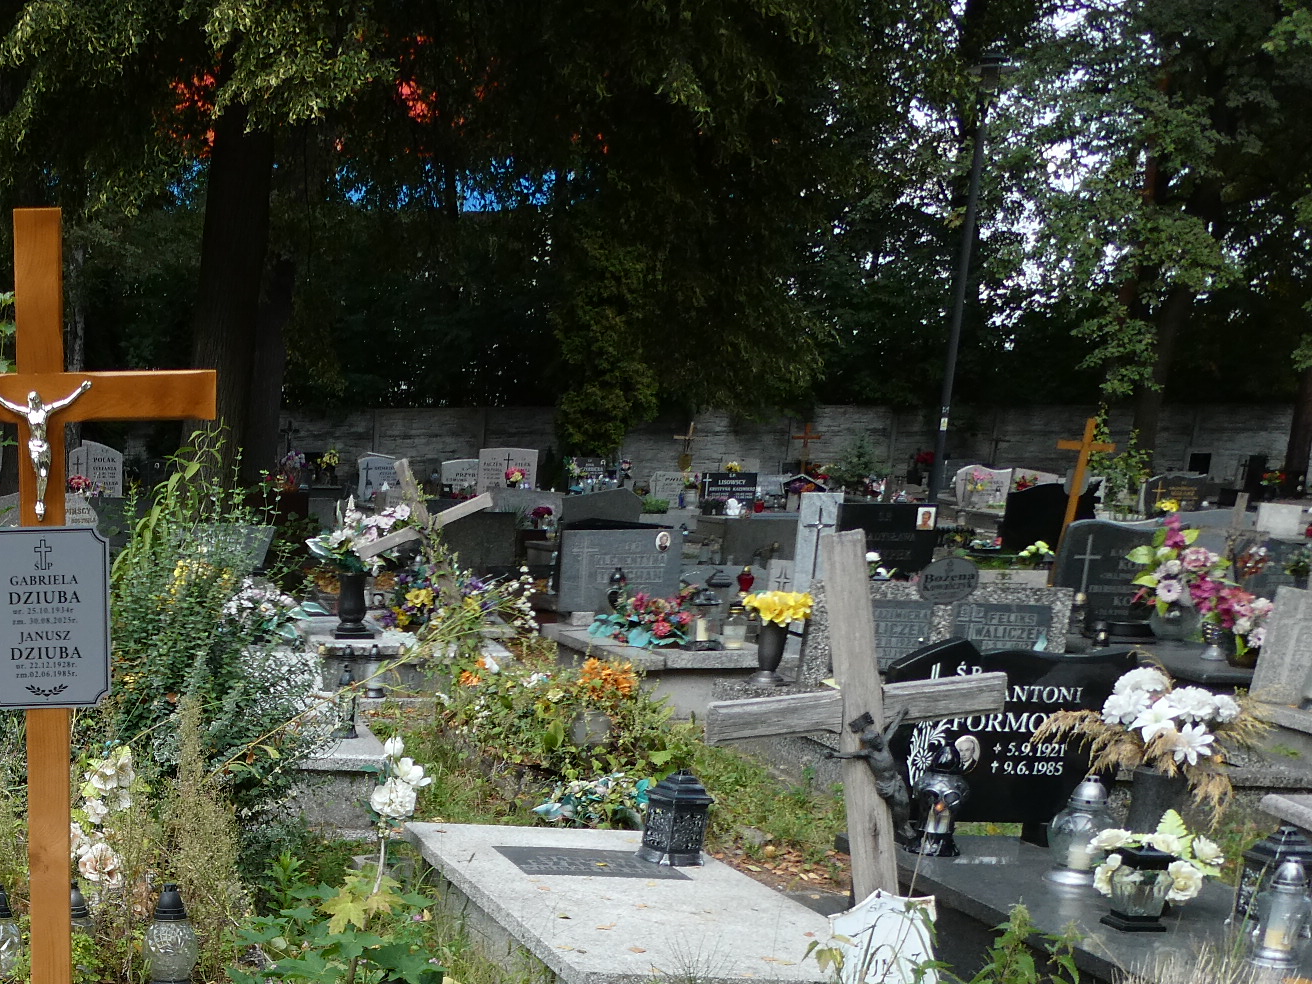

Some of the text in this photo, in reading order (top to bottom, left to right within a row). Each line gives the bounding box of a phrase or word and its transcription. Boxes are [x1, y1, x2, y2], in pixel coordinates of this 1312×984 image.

[10, 574, 78, 587] GABRIELA
[8, 590, 81, 605] DZIUBA
[12, 618, 27, 626] zm.
[989, 612, 1036, 625] FELIKS
[875, 621, 929, 637] LICZEK
[972, 625, 1047, 641] WALICZEK
[18, 631, 71, 645] JANUSZ
[10, 646, 82, 661] DZIUBA
[1003, 760, 1064, 776] 9.6.1985
